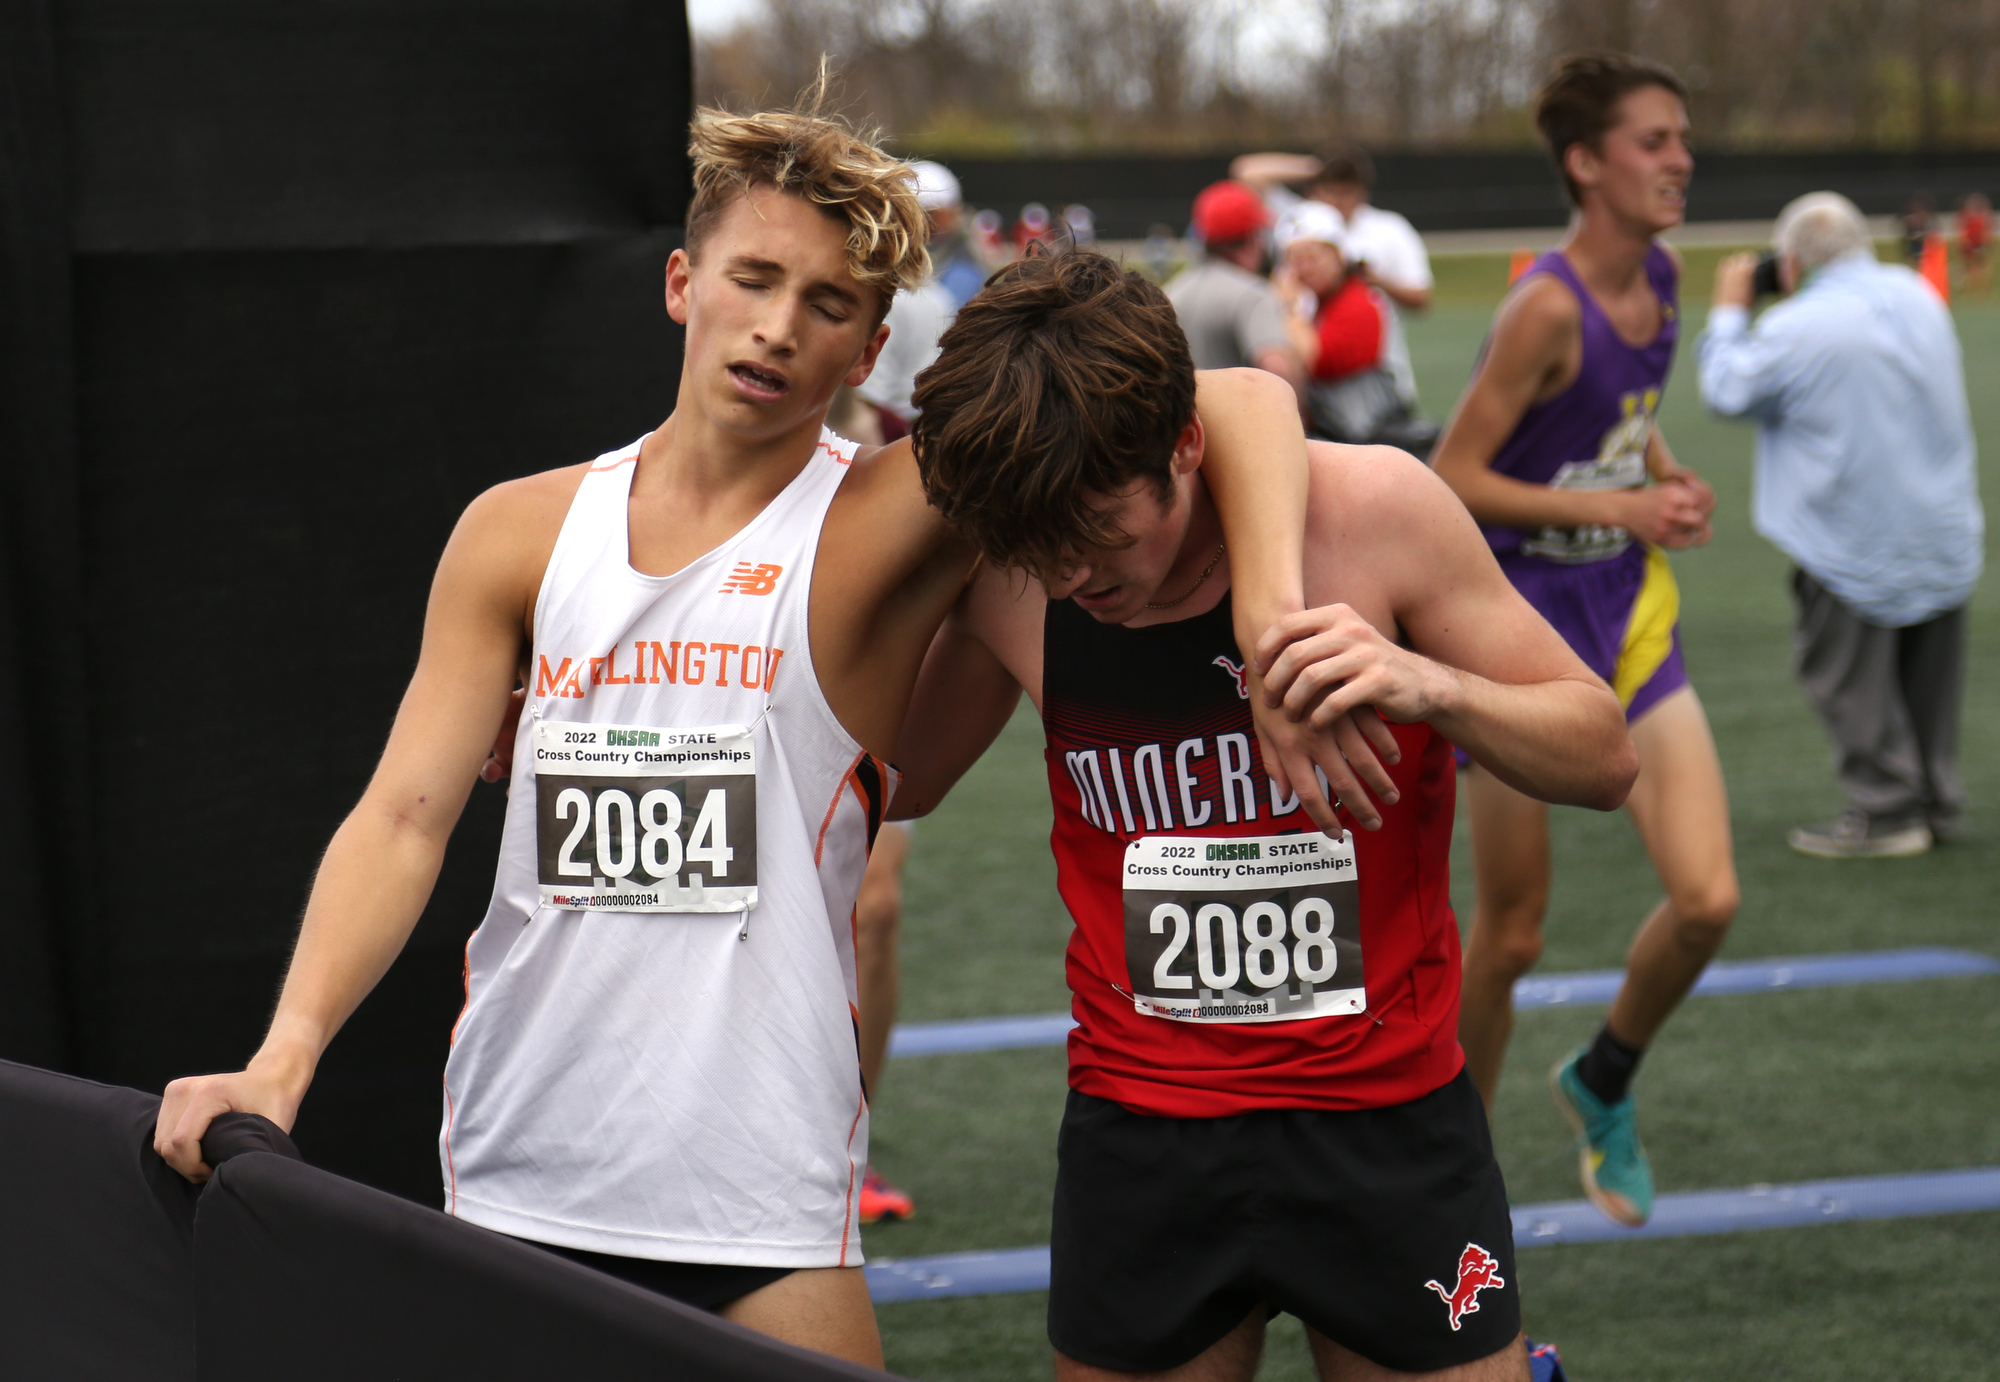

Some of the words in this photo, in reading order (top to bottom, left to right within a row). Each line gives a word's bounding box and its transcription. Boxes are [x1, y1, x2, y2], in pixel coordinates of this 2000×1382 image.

[564, 732, 597, 744] 2022
[606, 729, 661, 747] OHSAA
[668, 733, 717, 745] STATE
[537, 748, 571, 761] Cross
[575, 750, 629, 764] Country
[634, 749, 751, 763] Championships
[555, 788, 734, 878] 2084
[1161, 846, 1195, 858] 2022
[1205, 843, 1261, 861] OHSAA
[1268, 842, 1319, 857] STATE
[1127, 863, 1168, 875] Cross
[1172, 864, 1231, 879] Country
[1235, 857, 1353, 876] Championships
[1149, 897, 1338, 990] 2088
